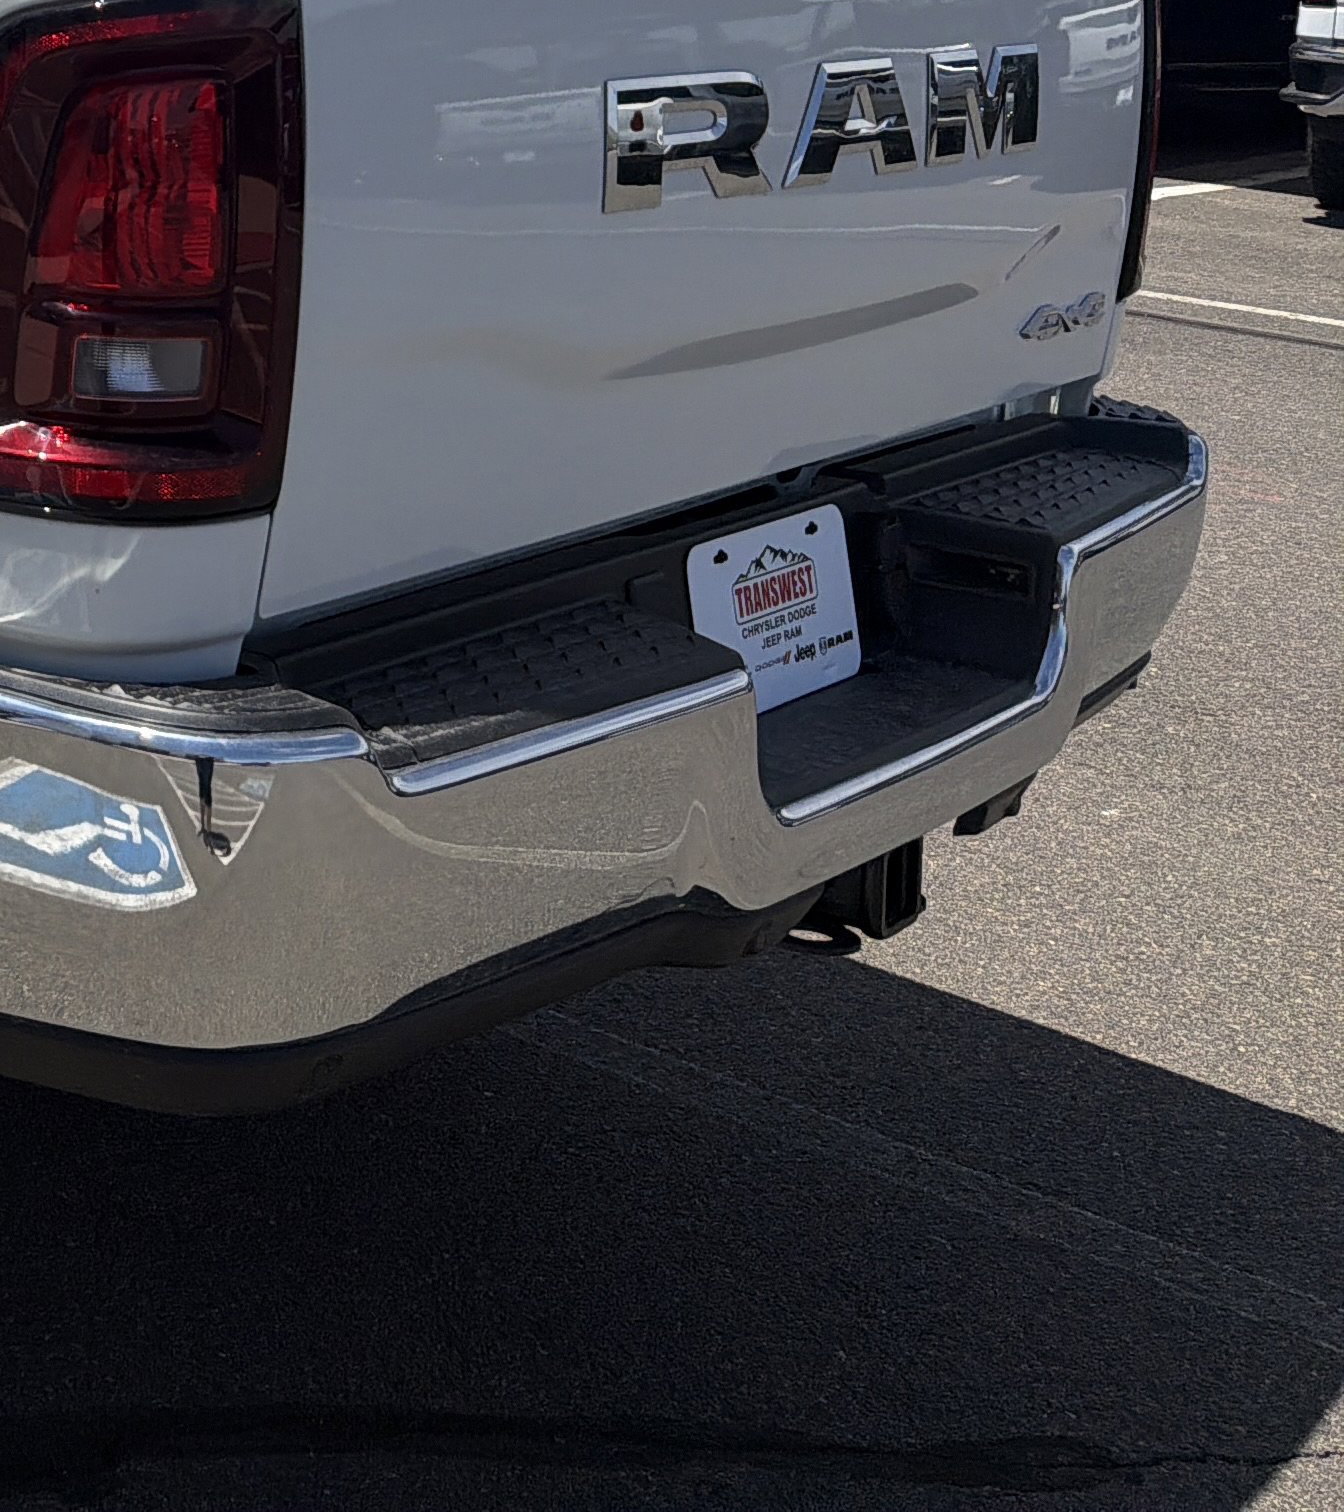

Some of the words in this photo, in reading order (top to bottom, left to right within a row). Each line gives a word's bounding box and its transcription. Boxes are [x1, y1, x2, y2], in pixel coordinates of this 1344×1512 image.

[602, 43, 1040, 214] RAM
[735, 564, 814, 618] TRANSWEST
[742, 614, 786, 639] CHRYSLER
[788, 603, 817, 624] DODGE
[762, 632, 782, 649] JEEP
[784, 625, 803, 643] RAM
[794, 643, 817, 663] Jeep
[827, 630, 854, 649] RAM
